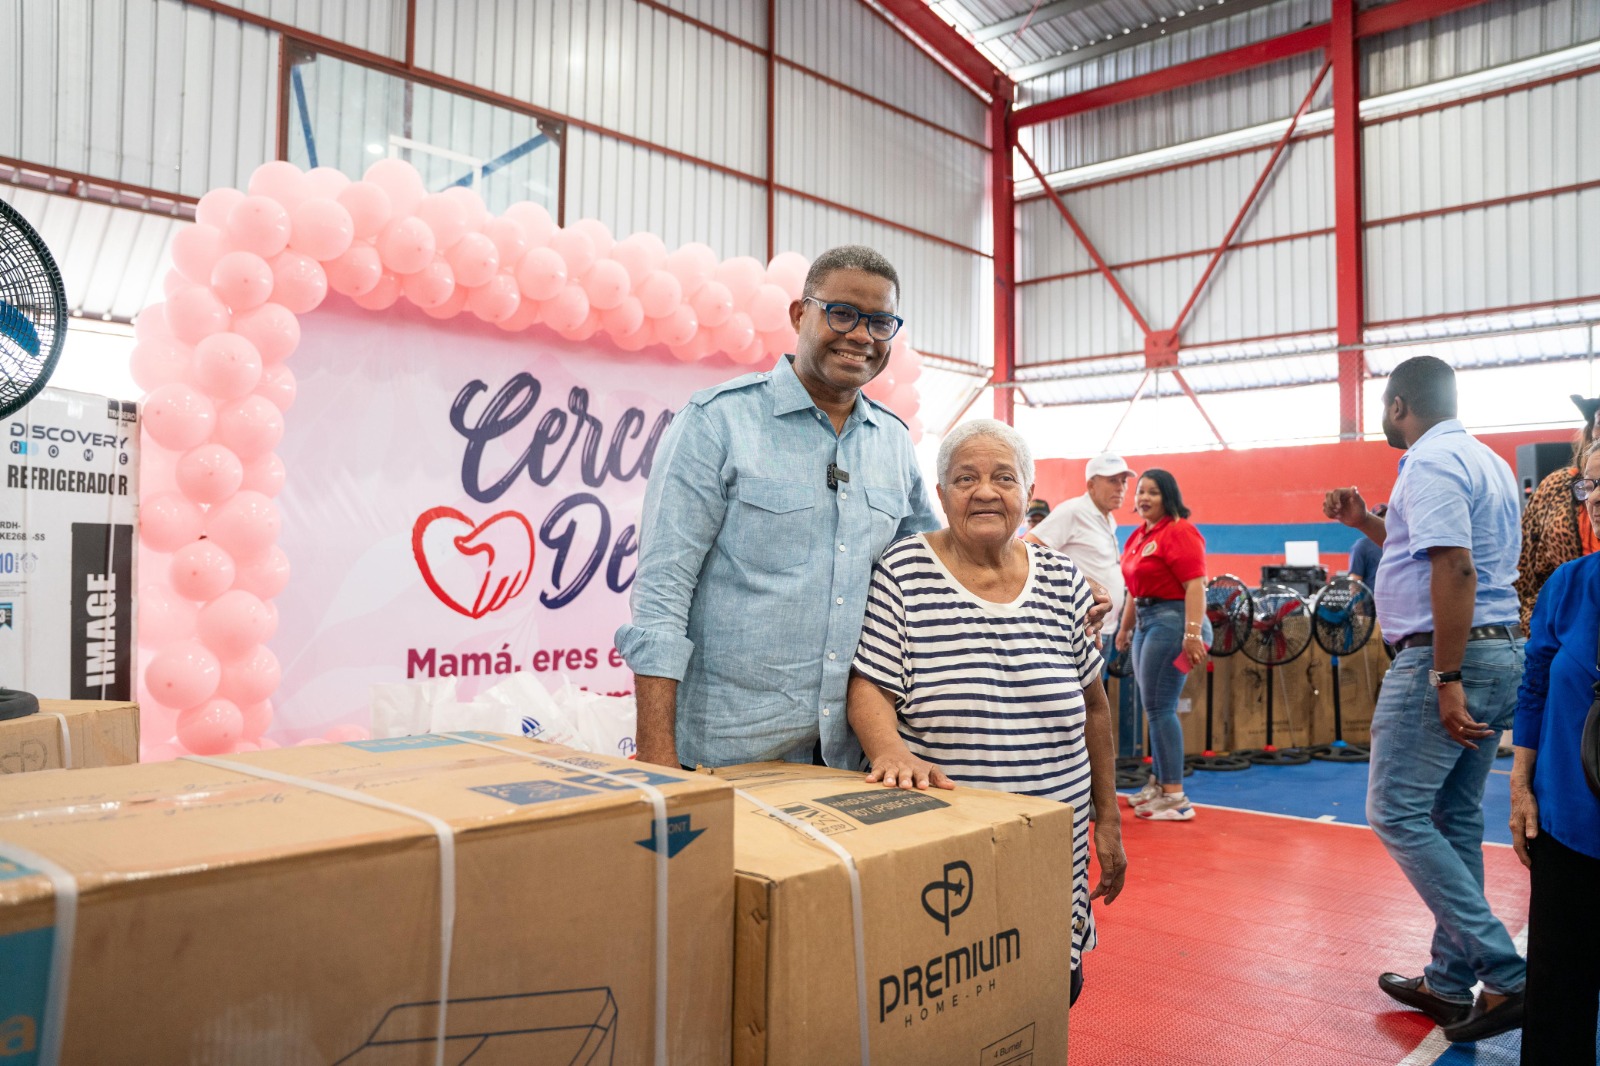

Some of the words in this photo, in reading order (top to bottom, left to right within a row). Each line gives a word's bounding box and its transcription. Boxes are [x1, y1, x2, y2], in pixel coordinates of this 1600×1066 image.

[10, 422, 129, 449] DISCOVERY
[11, 440, 128, 465] HOME
[7, 464, 128, 496] REFRIGERADOR
[0, 532, 46, 541] KE268-SS
[86, 573, 116, 687] IMAGE
[533, 647, 598, 672] eres
[846, 807, 872, 817] NOT
[868, 800, 909, 814] UPSIDE
[902, 795, 935, 806] DOWN
[879, 928, 1020, 1023] PREMIUM
[1000, 1040, 1022, 1057] Burner
